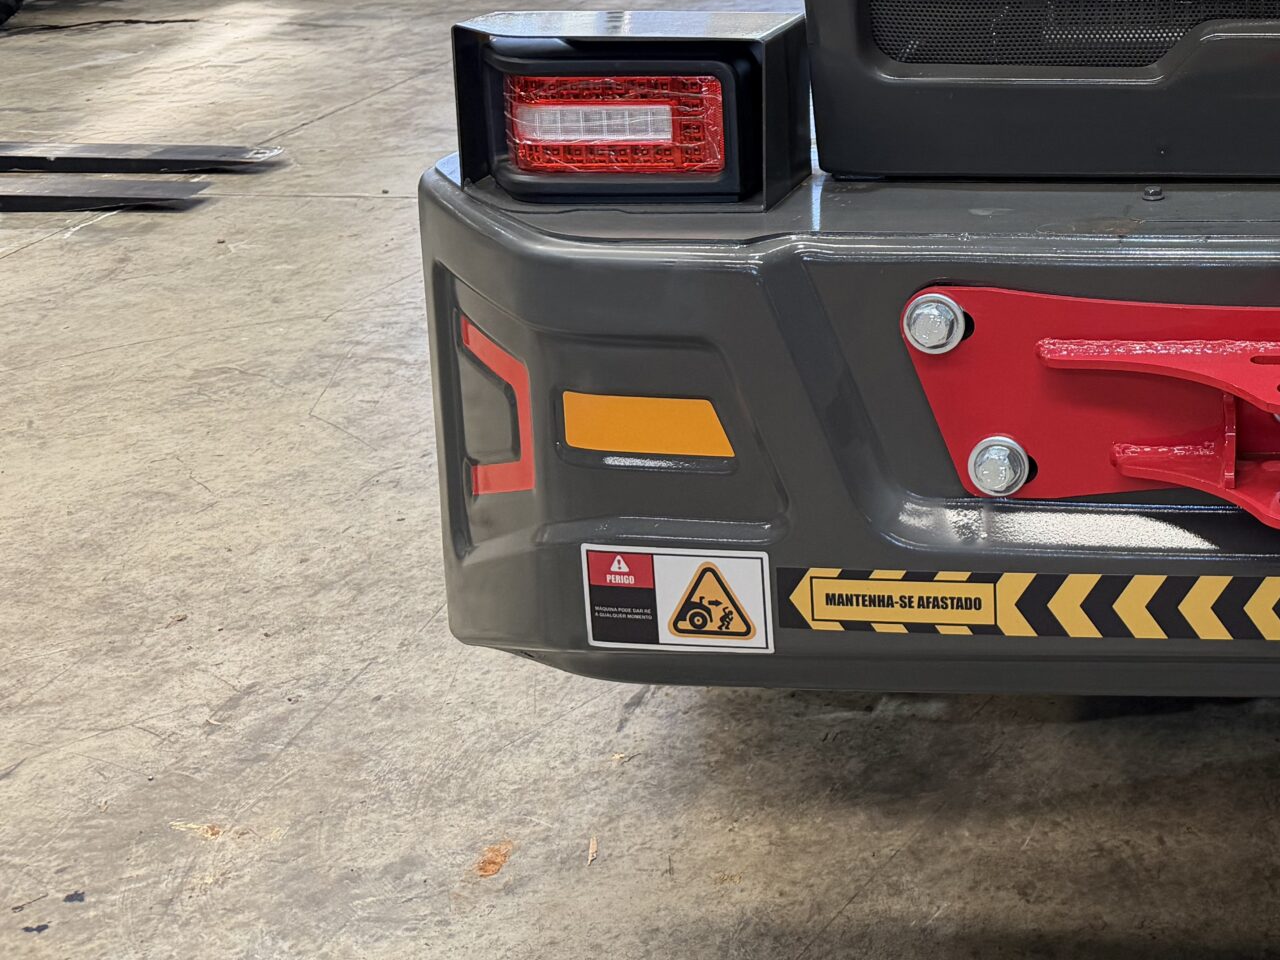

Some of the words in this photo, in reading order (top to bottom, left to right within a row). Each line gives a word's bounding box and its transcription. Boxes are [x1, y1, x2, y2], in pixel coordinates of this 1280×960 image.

[606, 574, 635, 584] PERIGO
[825, 592, 914, 609] MANTENHA-SE
[917, 595, 982, 611] AFASTADO
